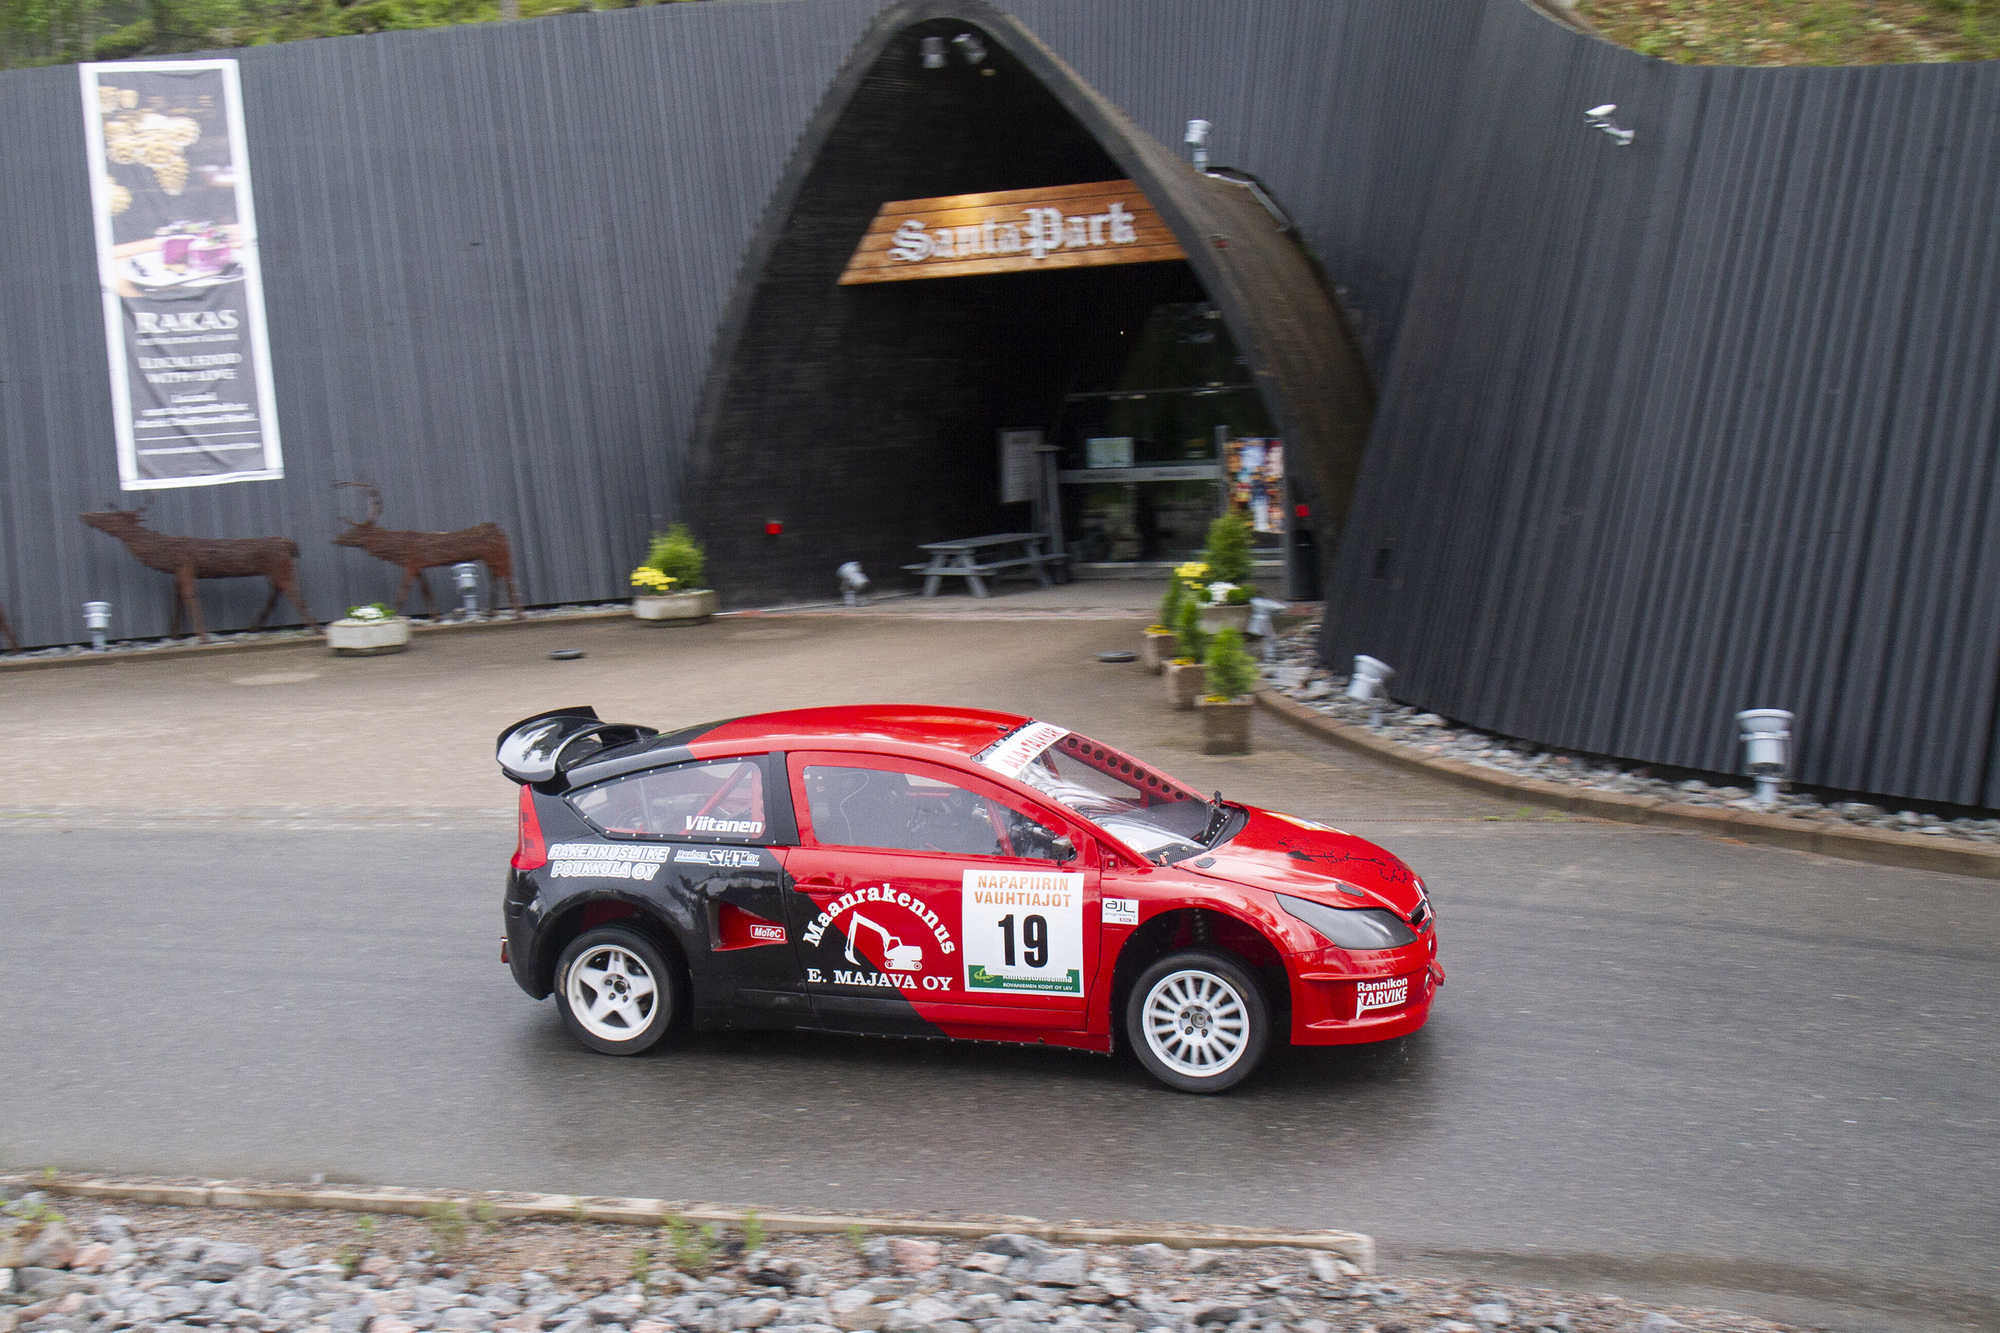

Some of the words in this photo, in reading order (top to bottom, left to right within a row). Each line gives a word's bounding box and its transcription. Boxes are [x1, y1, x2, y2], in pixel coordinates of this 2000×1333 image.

[133, 309, 239, 333] RAKAS
[685, 815, 763, 833] Viitanen
[547, 844, 670, 863] RAKENNUSLIIKE
[551, 861, 632, 878] POUKKULA
[631, 863, 660, 881] OY
[978, 875, 1068, 890] NAPAPIIRIN
[974, 891, 1071, 907] VAUHTIAJOT
[802, 883, 955, 955] Maanrakennus
[754, 927, 782, 938] MoTeC
[998, 914, 1048, 968] 19
[807, 968, 827, 983] E.
[833, 970, 917, 989] MAJAVA
[922, 976, 953, 991] OY
[1357, 977, 1408, 992] Rannikon
[1358, 986, 1408, 1006] TARVIKE
